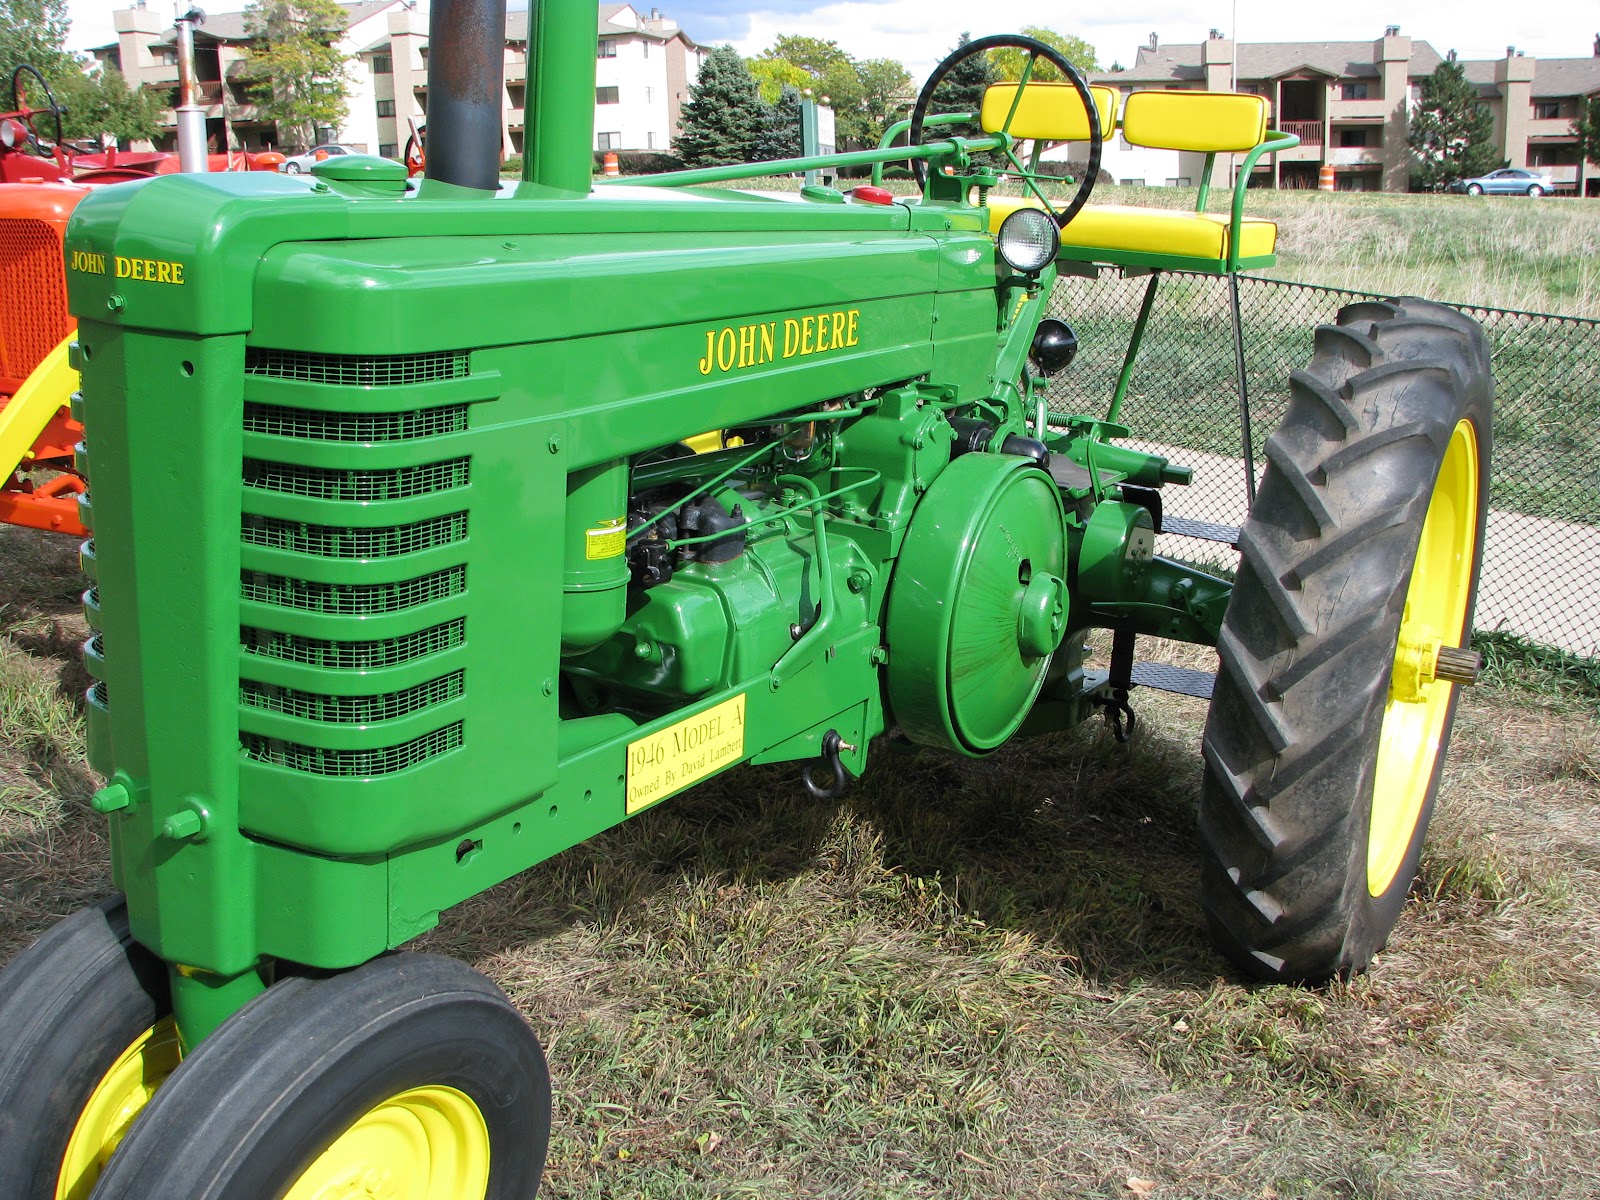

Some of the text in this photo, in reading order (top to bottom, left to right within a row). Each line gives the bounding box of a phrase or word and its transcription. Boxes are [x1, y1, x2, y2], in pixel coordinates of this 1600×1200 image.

[71, 250, 185, 285] JOHN DEERE
[698, 310, 860, 375] JOHN DEERE
[629, 738, 742, 803] Owned By David Lambert
[630, 703, 742, 777] 1946 MODEL A
